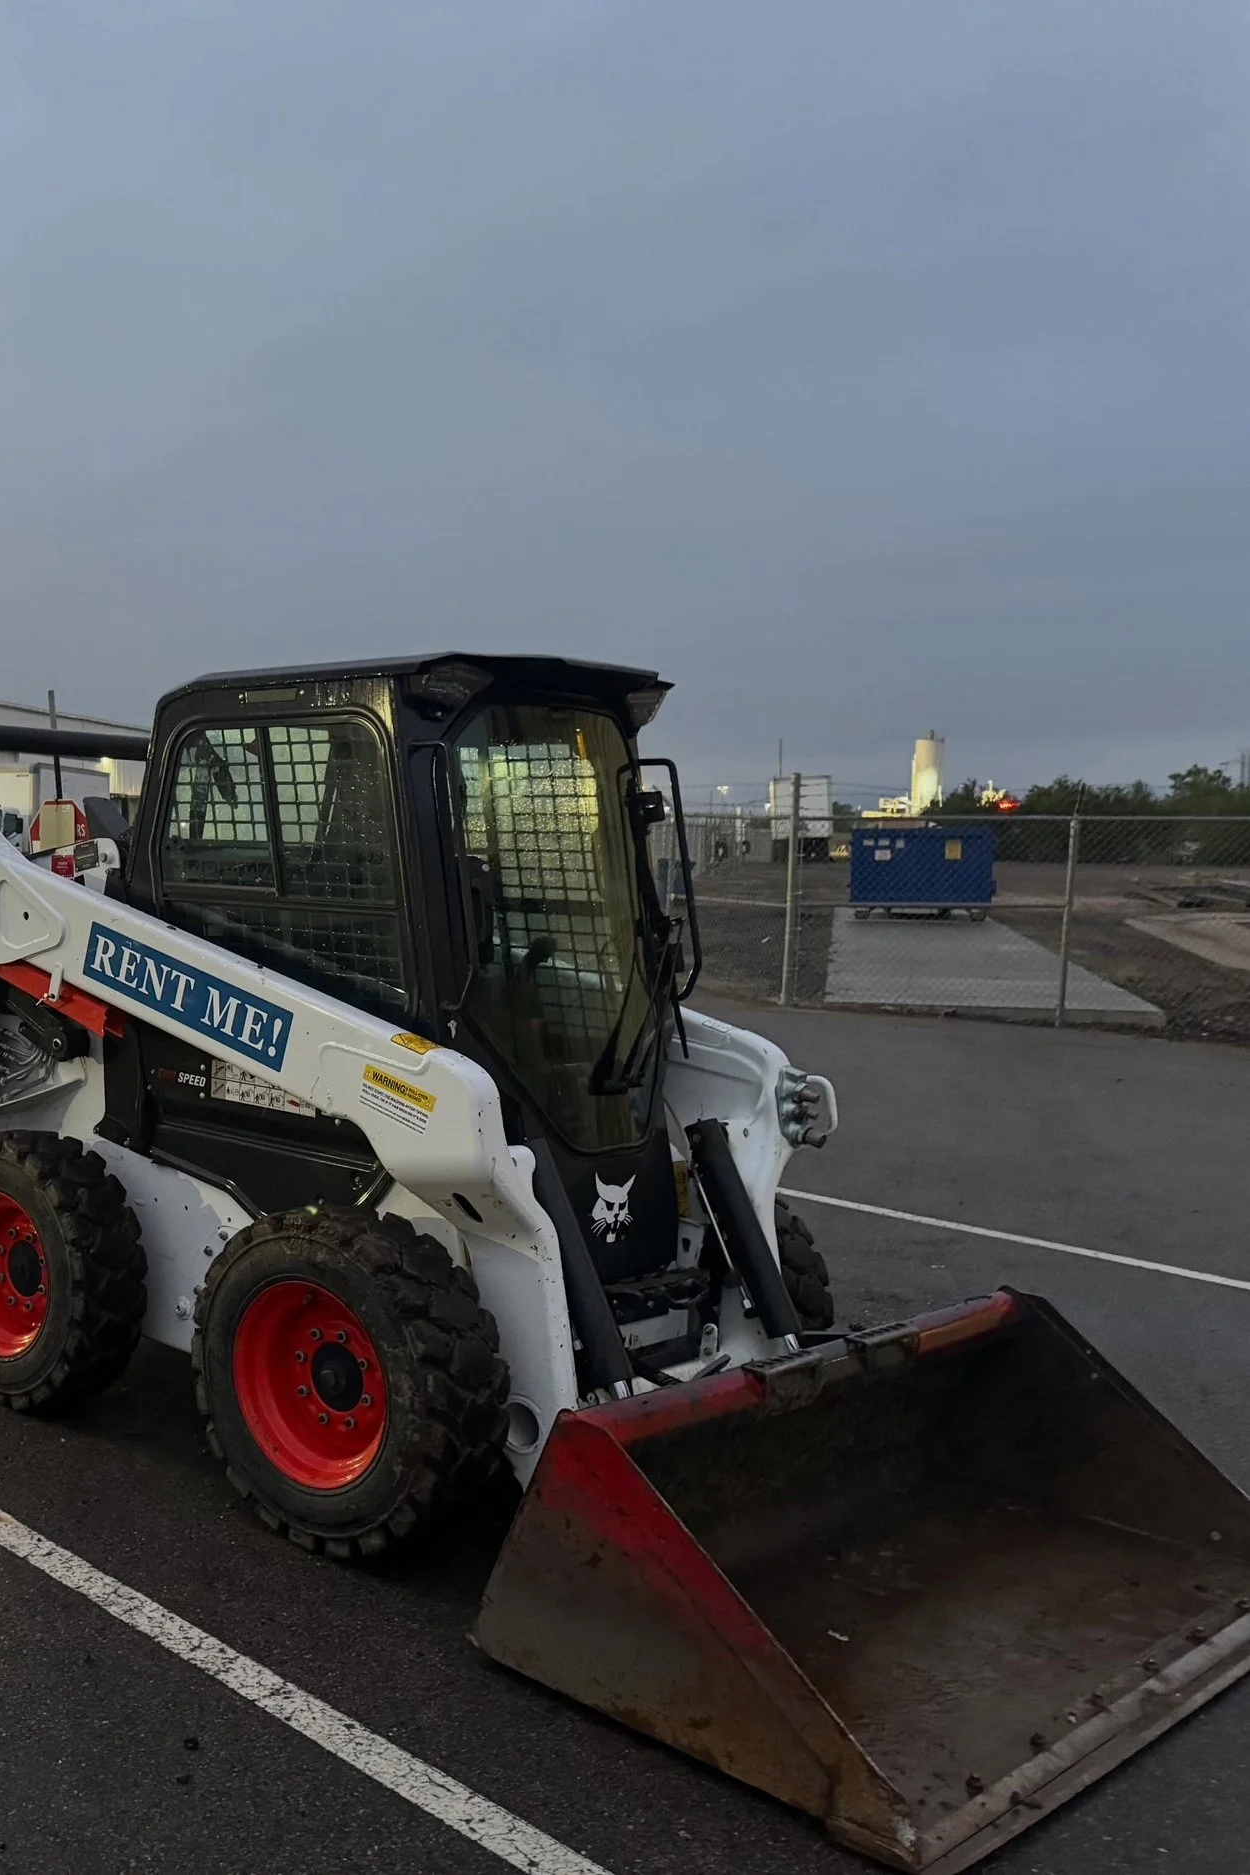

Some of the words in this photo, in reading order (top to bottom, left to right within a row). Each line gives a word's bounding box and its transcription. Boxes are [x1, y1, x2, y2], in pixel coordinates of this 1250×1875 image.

[90, 934, 196, 1013] RENT
[200, 986, 283, 1057] ME!
[178, 1072, 206, 1087] SPEED
[372, 1070, 408, 1095] WARNING!
